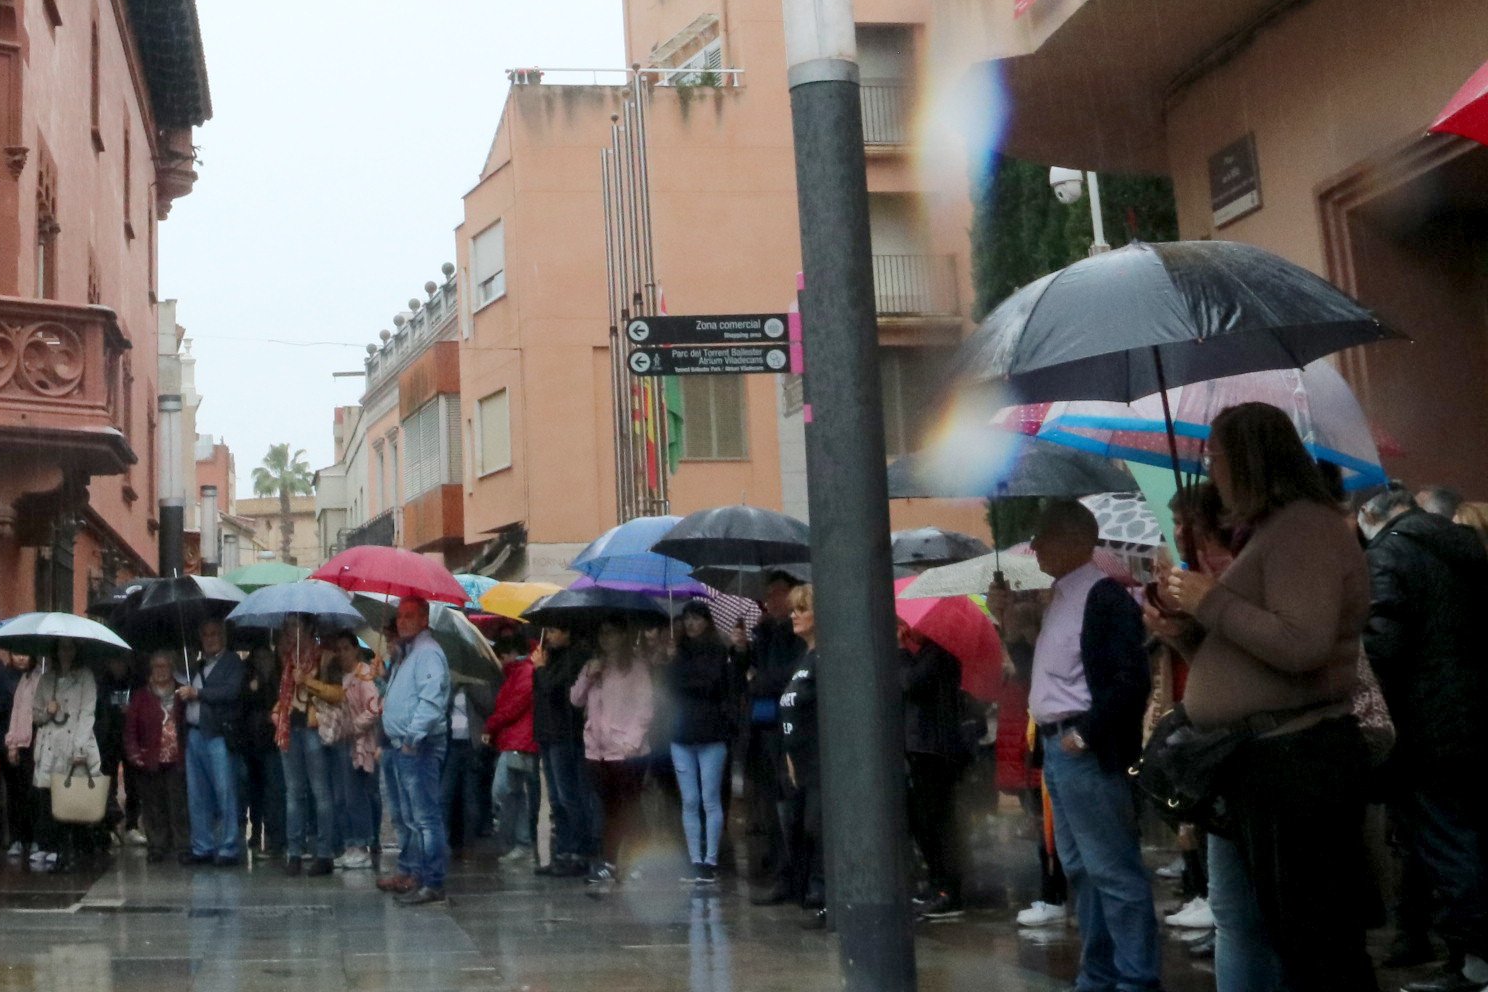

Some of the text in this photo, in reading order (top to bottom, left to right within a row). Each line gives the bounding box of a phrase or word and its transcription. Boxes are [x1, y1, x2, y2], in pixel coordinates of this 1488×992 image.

[696, 319, 761, 330] Zona comercial
[671, 348, 763, 358] Parc del Torrent Ballester
[724, 356, 764, 365] Viladecans
